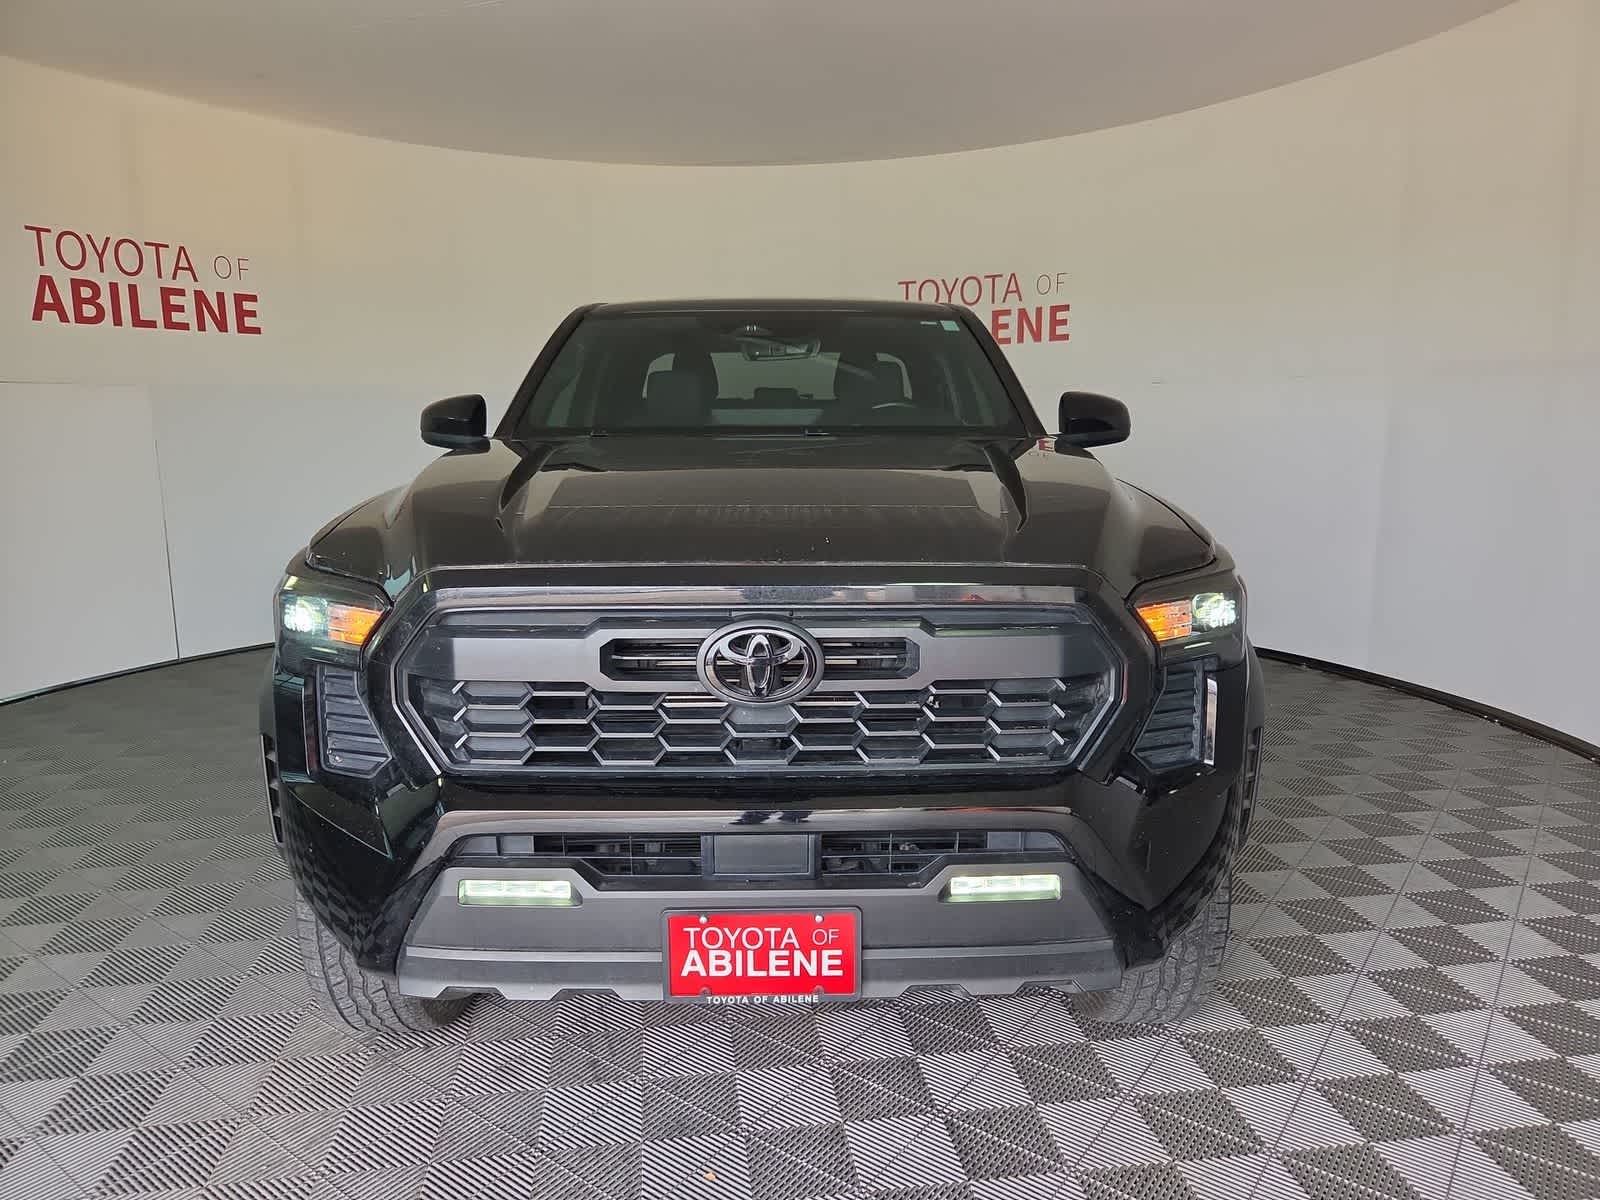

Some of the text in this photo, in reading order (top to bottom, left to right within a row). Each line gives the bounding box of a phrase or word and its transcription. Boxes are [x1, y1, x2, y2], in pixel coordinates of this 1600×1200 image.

[24, 225, 249, 282] TOYOTA OF
[32, 274, 262, 335] ABILENE
[898, 272, 1068, 306] TOYOTA OF
[683, 927, 840, 949] TOYOTA OF
[680, 949, 844, 977] ABILENE
[706, 994, 819, 1005] TOYOTA OF ABILENE
